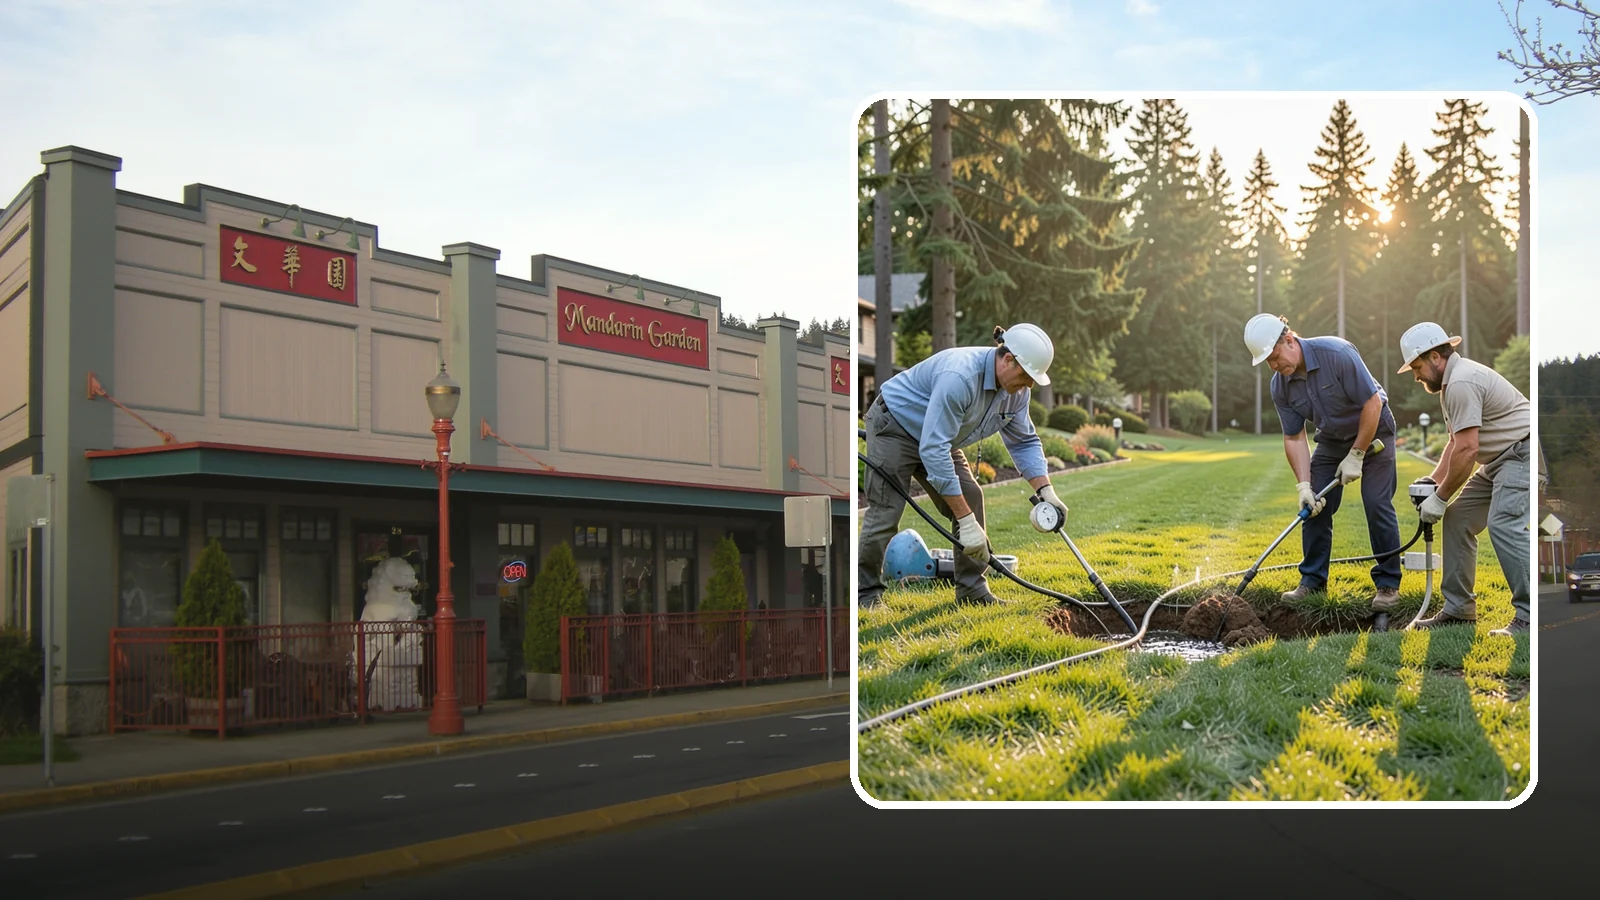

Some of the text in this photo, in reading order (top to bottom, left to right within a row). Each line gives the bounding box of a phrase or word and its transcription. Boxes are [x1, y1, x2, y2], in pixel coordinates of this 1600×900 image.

[230, 235, 346, 291] 文華園
[564, 302, 702, 352] Mandarin Garden
[503, 565, 527, 578] OPEN
